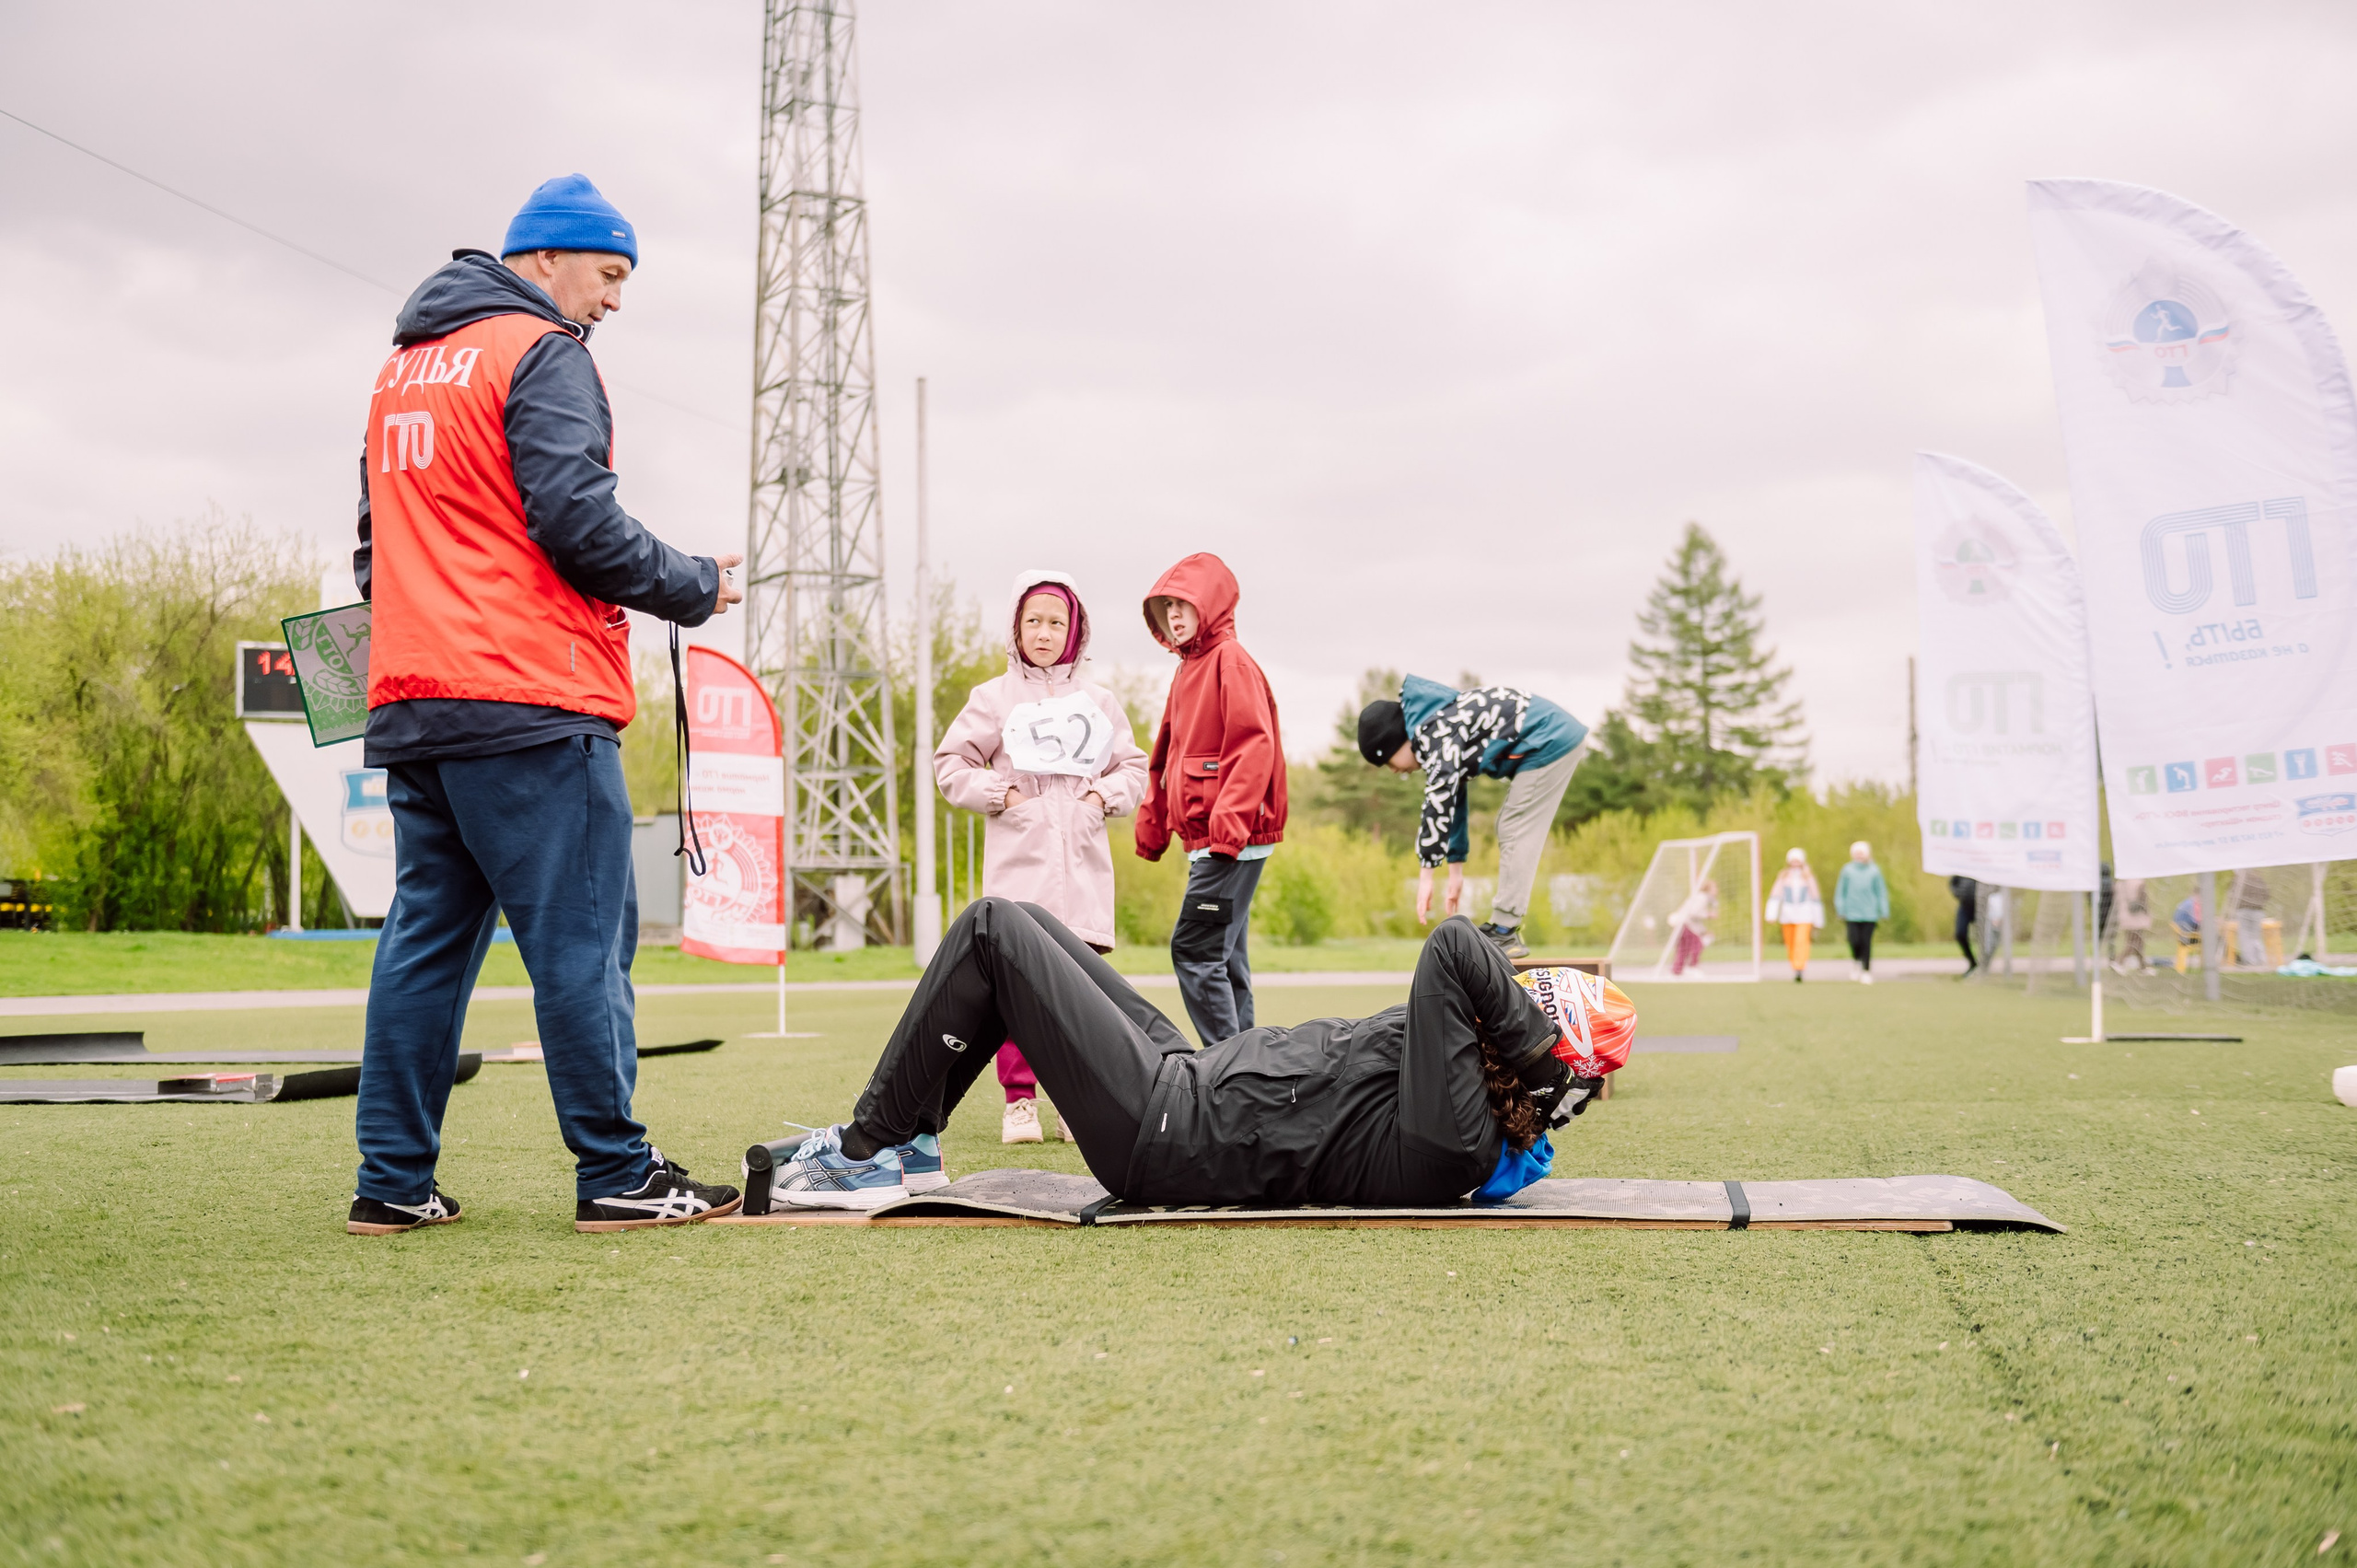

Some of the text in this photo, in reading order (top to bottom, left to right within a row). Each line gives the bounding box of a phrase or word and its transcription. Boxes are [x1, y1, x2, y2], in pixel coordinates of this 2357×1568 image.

[381, 411, 435, 473] ГТО
[316, 633, 345, 669] ГТО
[1028, 714, 1095, 764] 52
